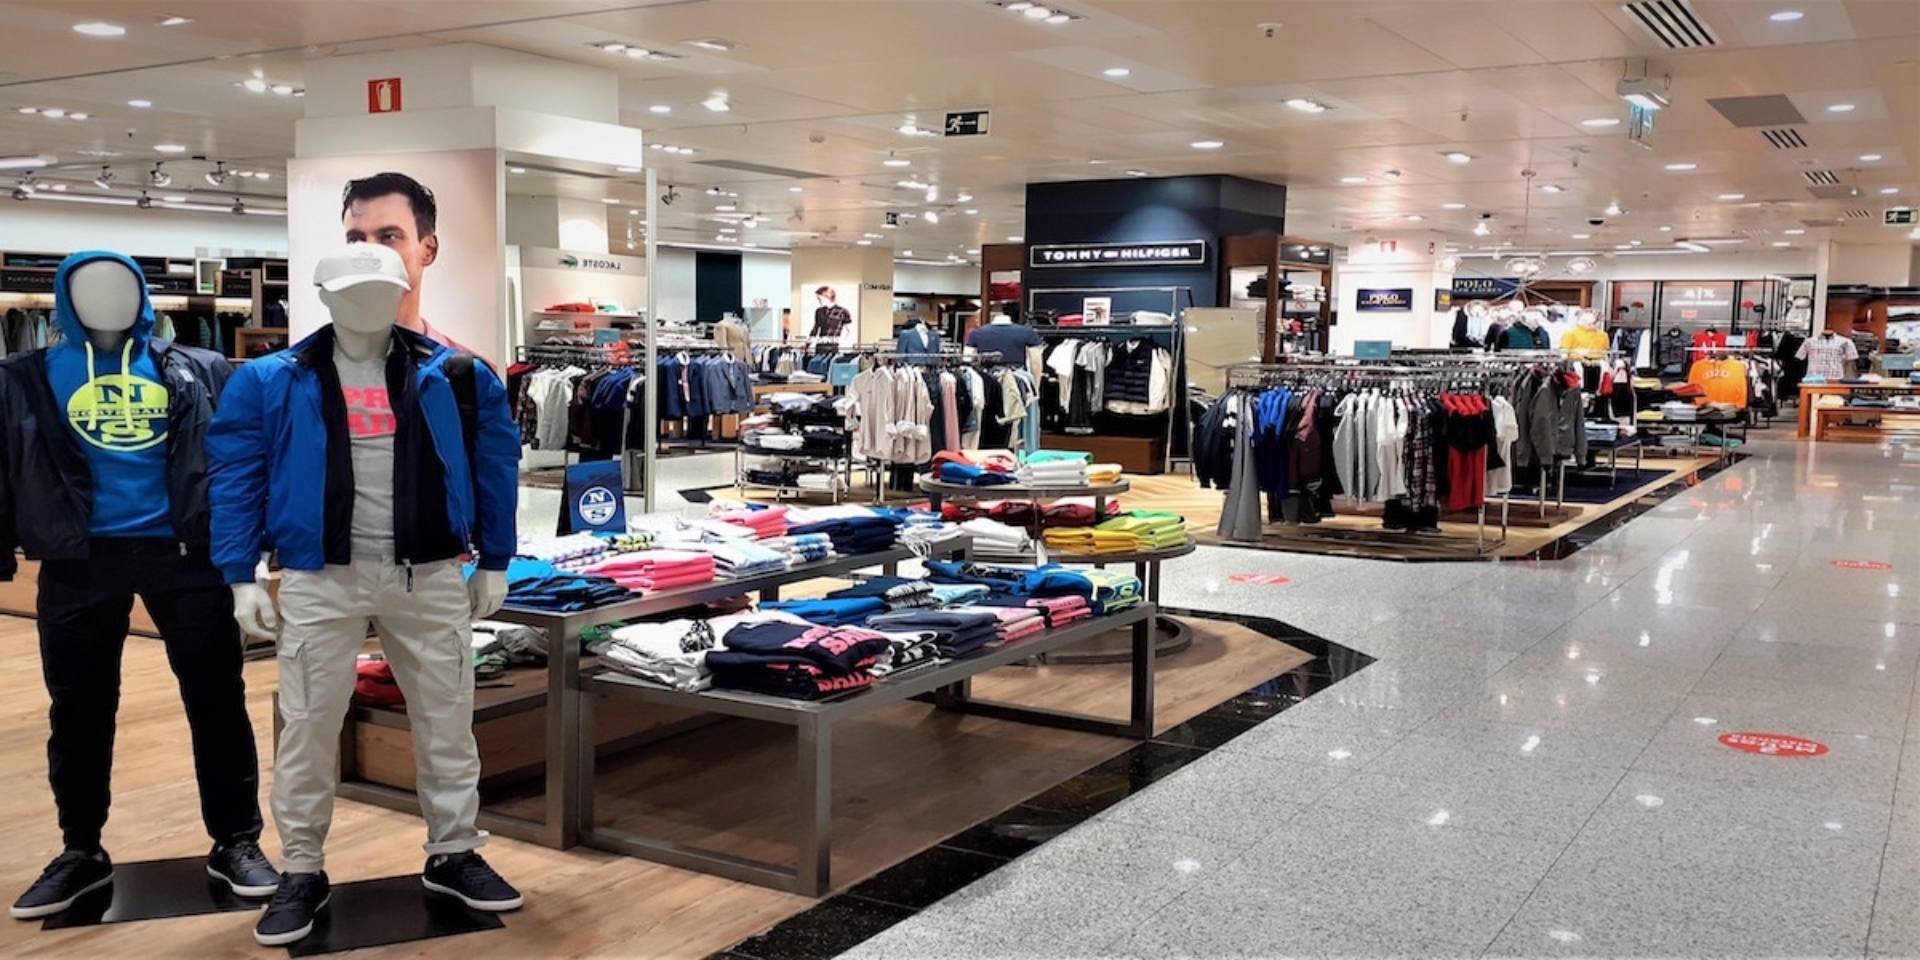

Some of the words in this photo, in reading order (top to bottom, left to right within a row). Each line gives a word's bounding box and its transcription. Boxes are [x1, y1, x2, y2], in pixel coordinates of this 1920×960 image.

[1043, 250, 1101, 261] TOMMY
[1120, 248, 1190, 259] HILFIGER
[1455, 279, 1493, 288] POLO
